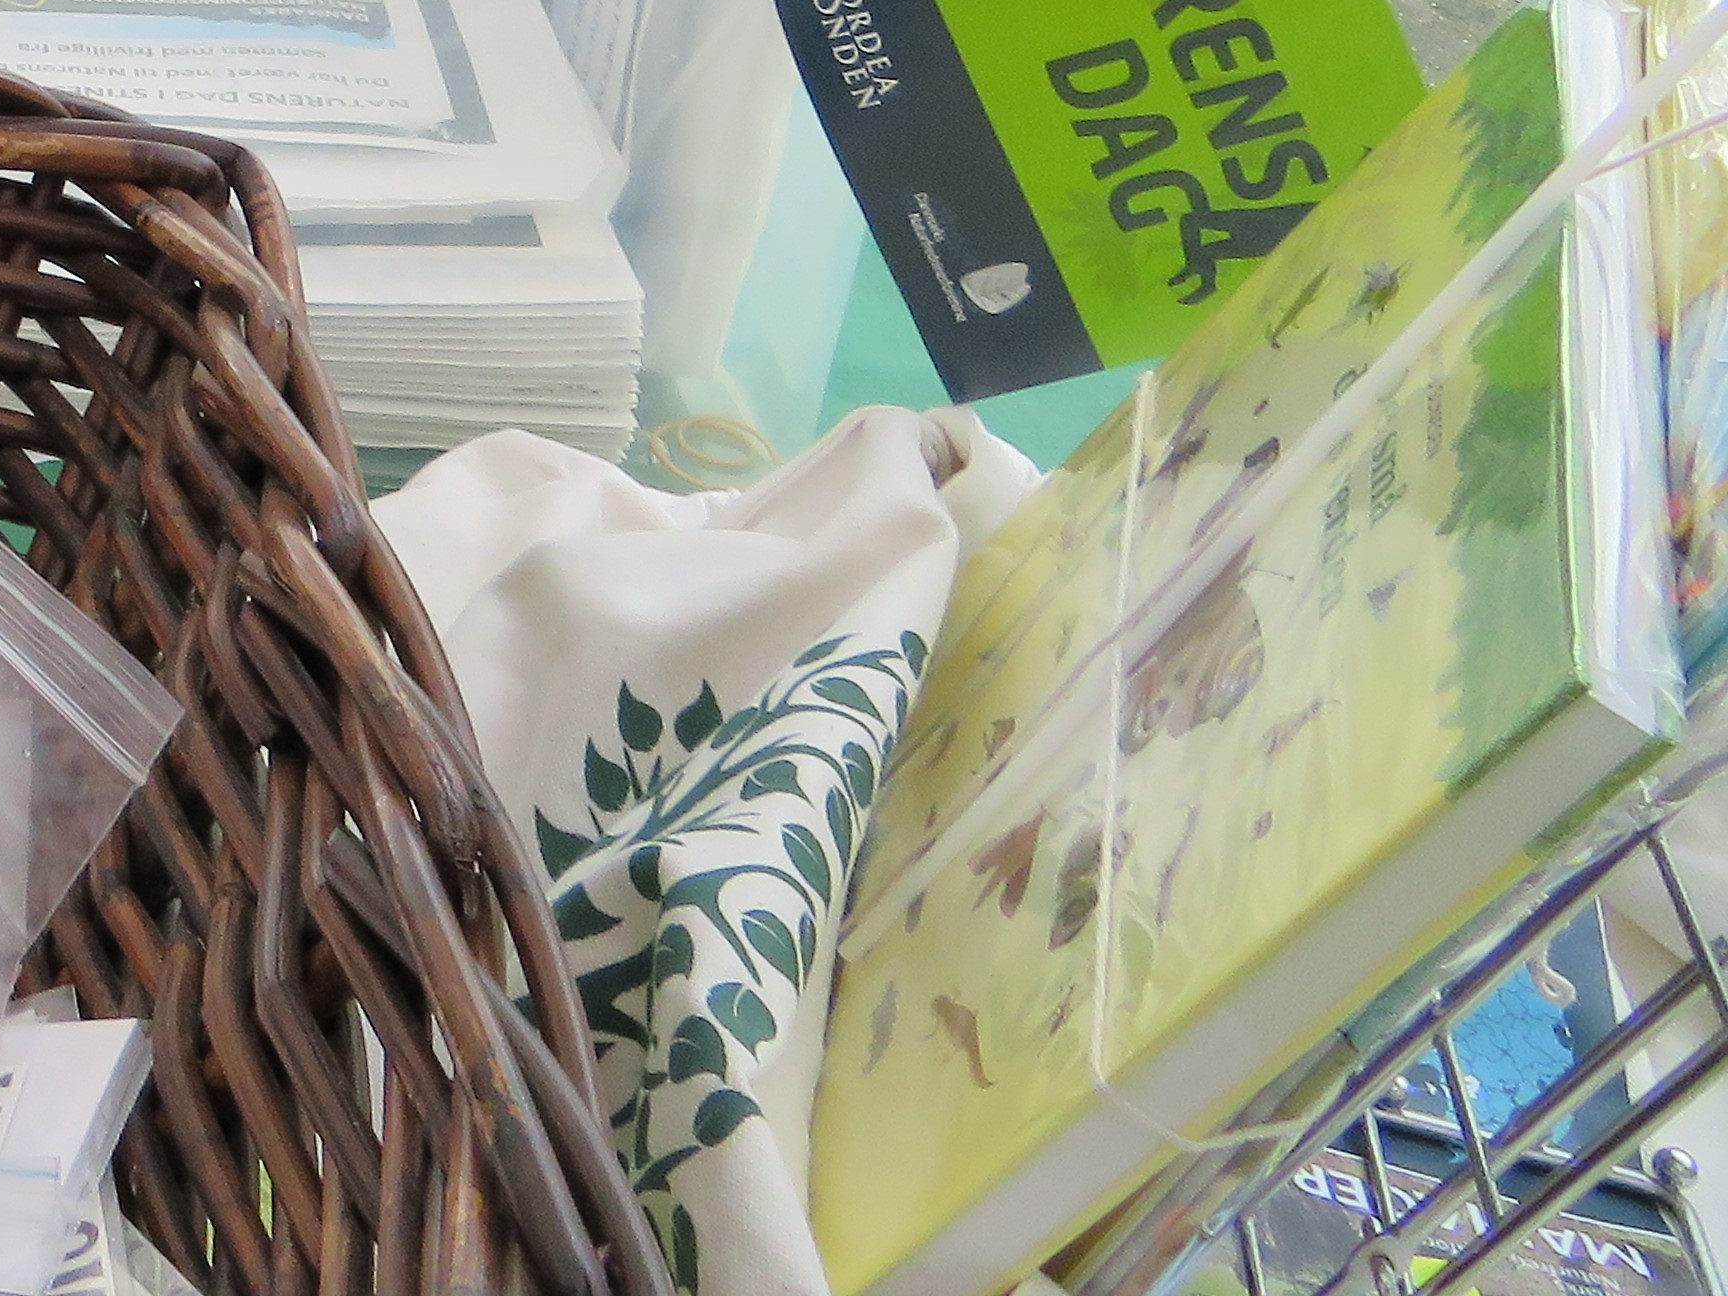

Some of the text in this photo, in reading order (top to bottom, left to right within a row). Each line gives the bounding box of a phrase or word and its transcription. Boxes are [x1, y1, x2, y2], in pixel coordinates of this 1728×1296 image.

[249, 7, 371, 23] DANMARKS
[17, 41, 327, 59] sammen med frivillige fra
[14, 61, 126, 78] Naturens
[133, 64, 158, 79] til
[225, 66, 300, 81] været
[307, 70, 348, 86] har
[355, 75, 390, 87] Du
[175, 89, 240, 105] DAG
[248, 91, 410, 109] NATURENS
[1045, 37, 1213, 234] DAG
